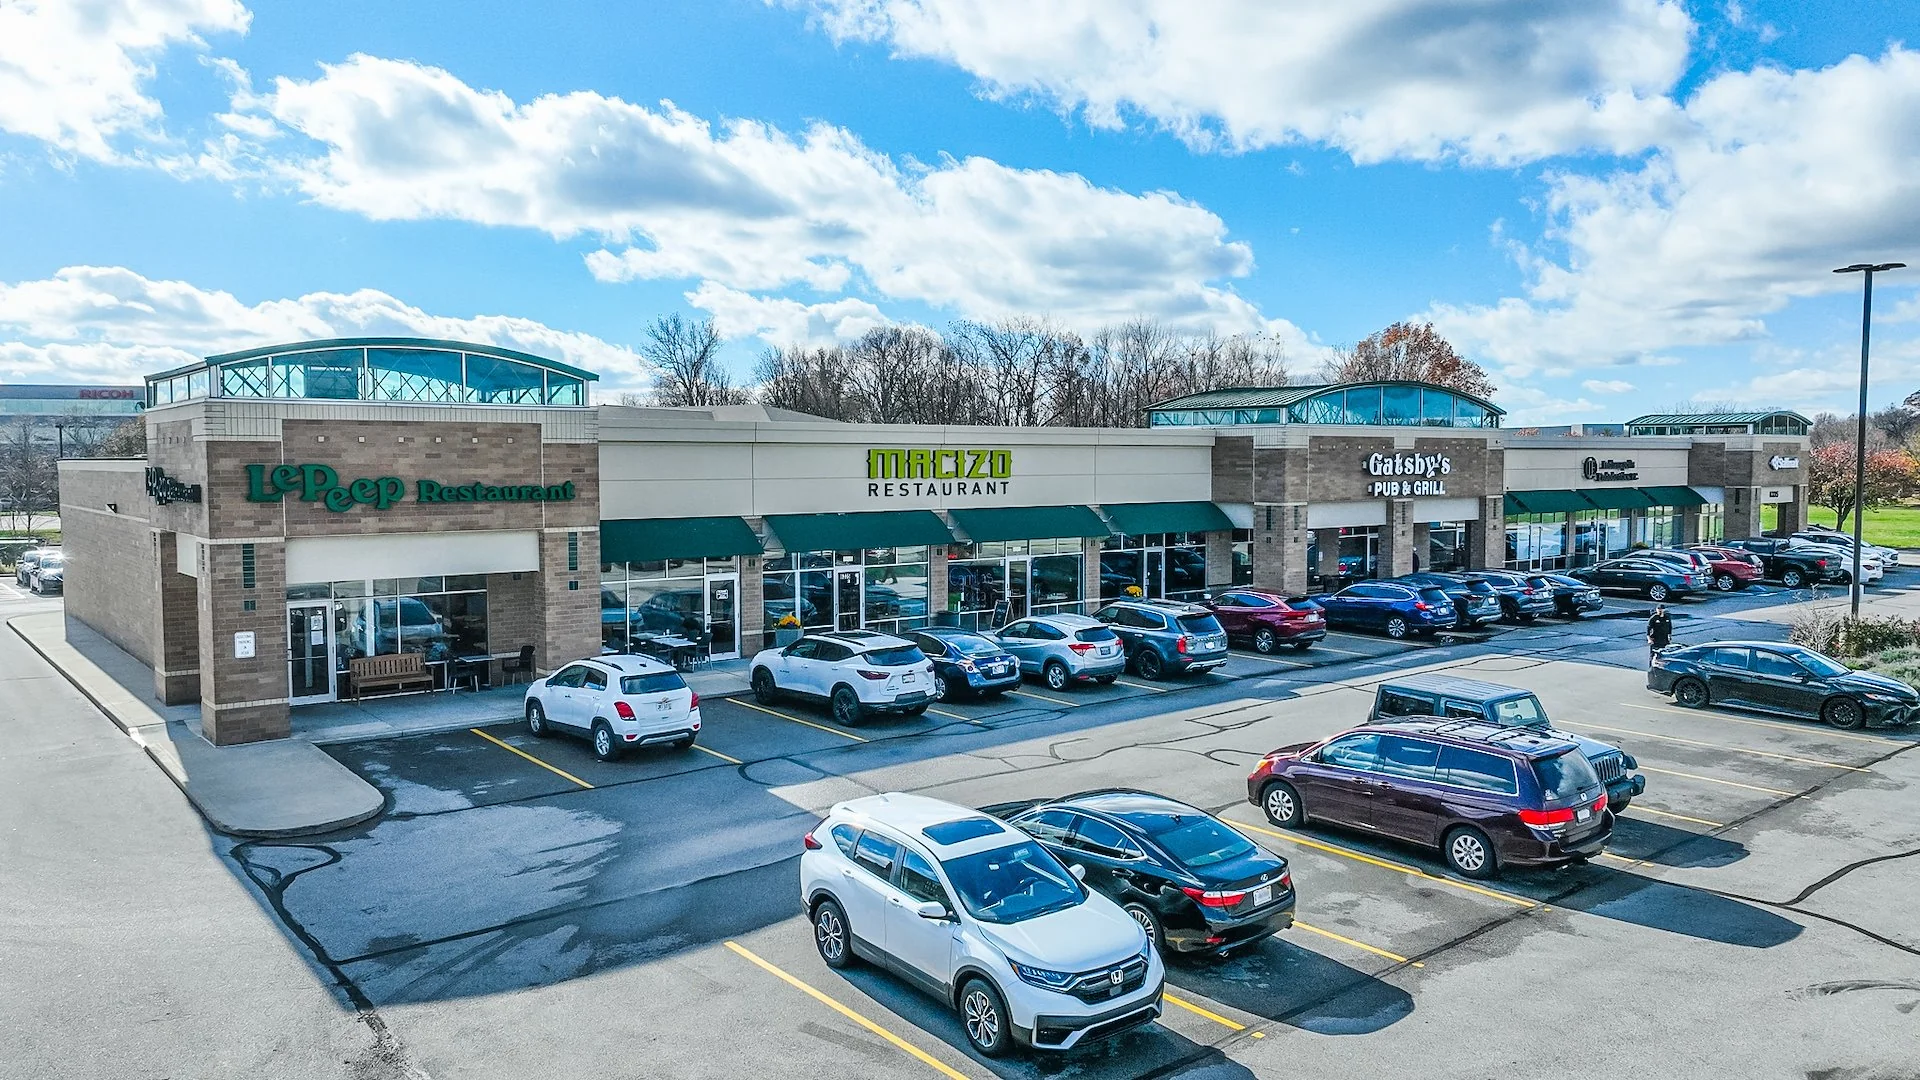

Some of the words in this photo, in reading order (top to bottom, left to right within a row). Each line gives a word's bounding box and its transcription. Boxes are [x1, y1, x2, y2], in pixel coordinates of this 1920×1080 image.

[79, 389, 134, 399] RICOH
[866, 449, 1012, 479] MACIZO
[1369, 452, 1451, 478] Gatsby's
[416, 479, 576, 502] Restaurant
[868, 481, 1010, 497] RESTAURANT
[1374, 481, 1400, 497] PUB
[1402, 480, 1412, 496] &
[1413, 480, 1446, 496] GRILL
